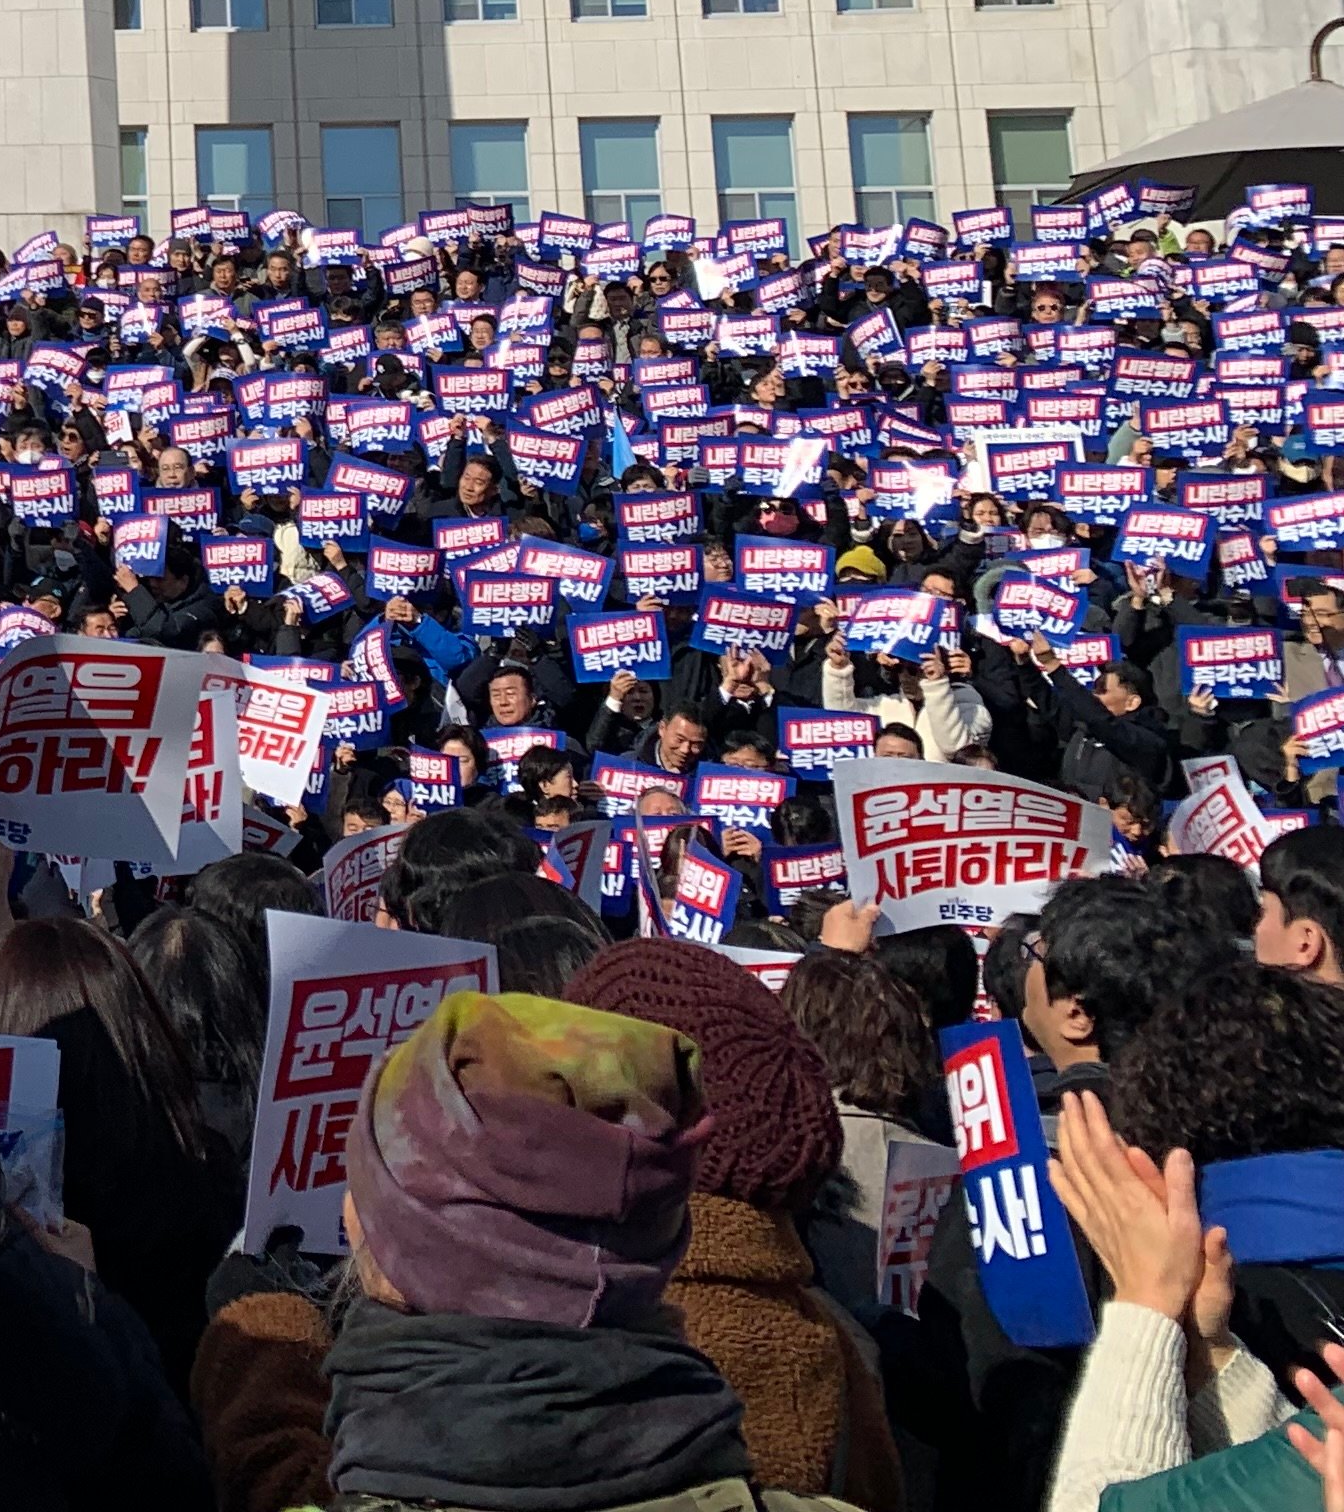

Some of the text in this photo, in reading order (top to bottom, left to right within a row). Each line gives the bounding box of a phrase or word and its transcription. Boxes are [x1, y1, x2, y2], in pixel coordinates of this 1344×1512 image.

[1119, 358, 1193, 377] 내란행위
[440, 373, 503, 394] 내란행위
[1148, 403, 1221, 429] 내란행위
[510, 434, 576, 460] 내란행위
[1063, 473, 1141, 492] 내란행위
[1188, 480, 1262, 504] 내란행위
[147, 492, 212, 514] 내란행위
[624, 497, 691, 523] 내란행위
[440, 523, 500, 548] 내란행위
[1127, 513, 1204, 537] 내란행위
[206, 543, 262, 564] 내란행위
[373, 550, 435, 572] 내란행위
[624, 550, 692, 572] 내란행위
[744, 547, 822, 569] 내란행위
[473, 581, 549, 603] 내란행위
[708, 600, 790, 628] 내란행위
[577, 617, 654, 652] 내란행위
[1191, 636, 1273, 661] 내란행위
[1193, 659, 1281, 683] 즉각수사!
[791, 720, 874, 744] 내란행위
[702, 779, 781, 804] 내란행위
[863, 791, 1068, 843] 윤석열은
[874, 846, 1088, 904] 사퇴하라!
[939, 902, 994, 922] 민주당
